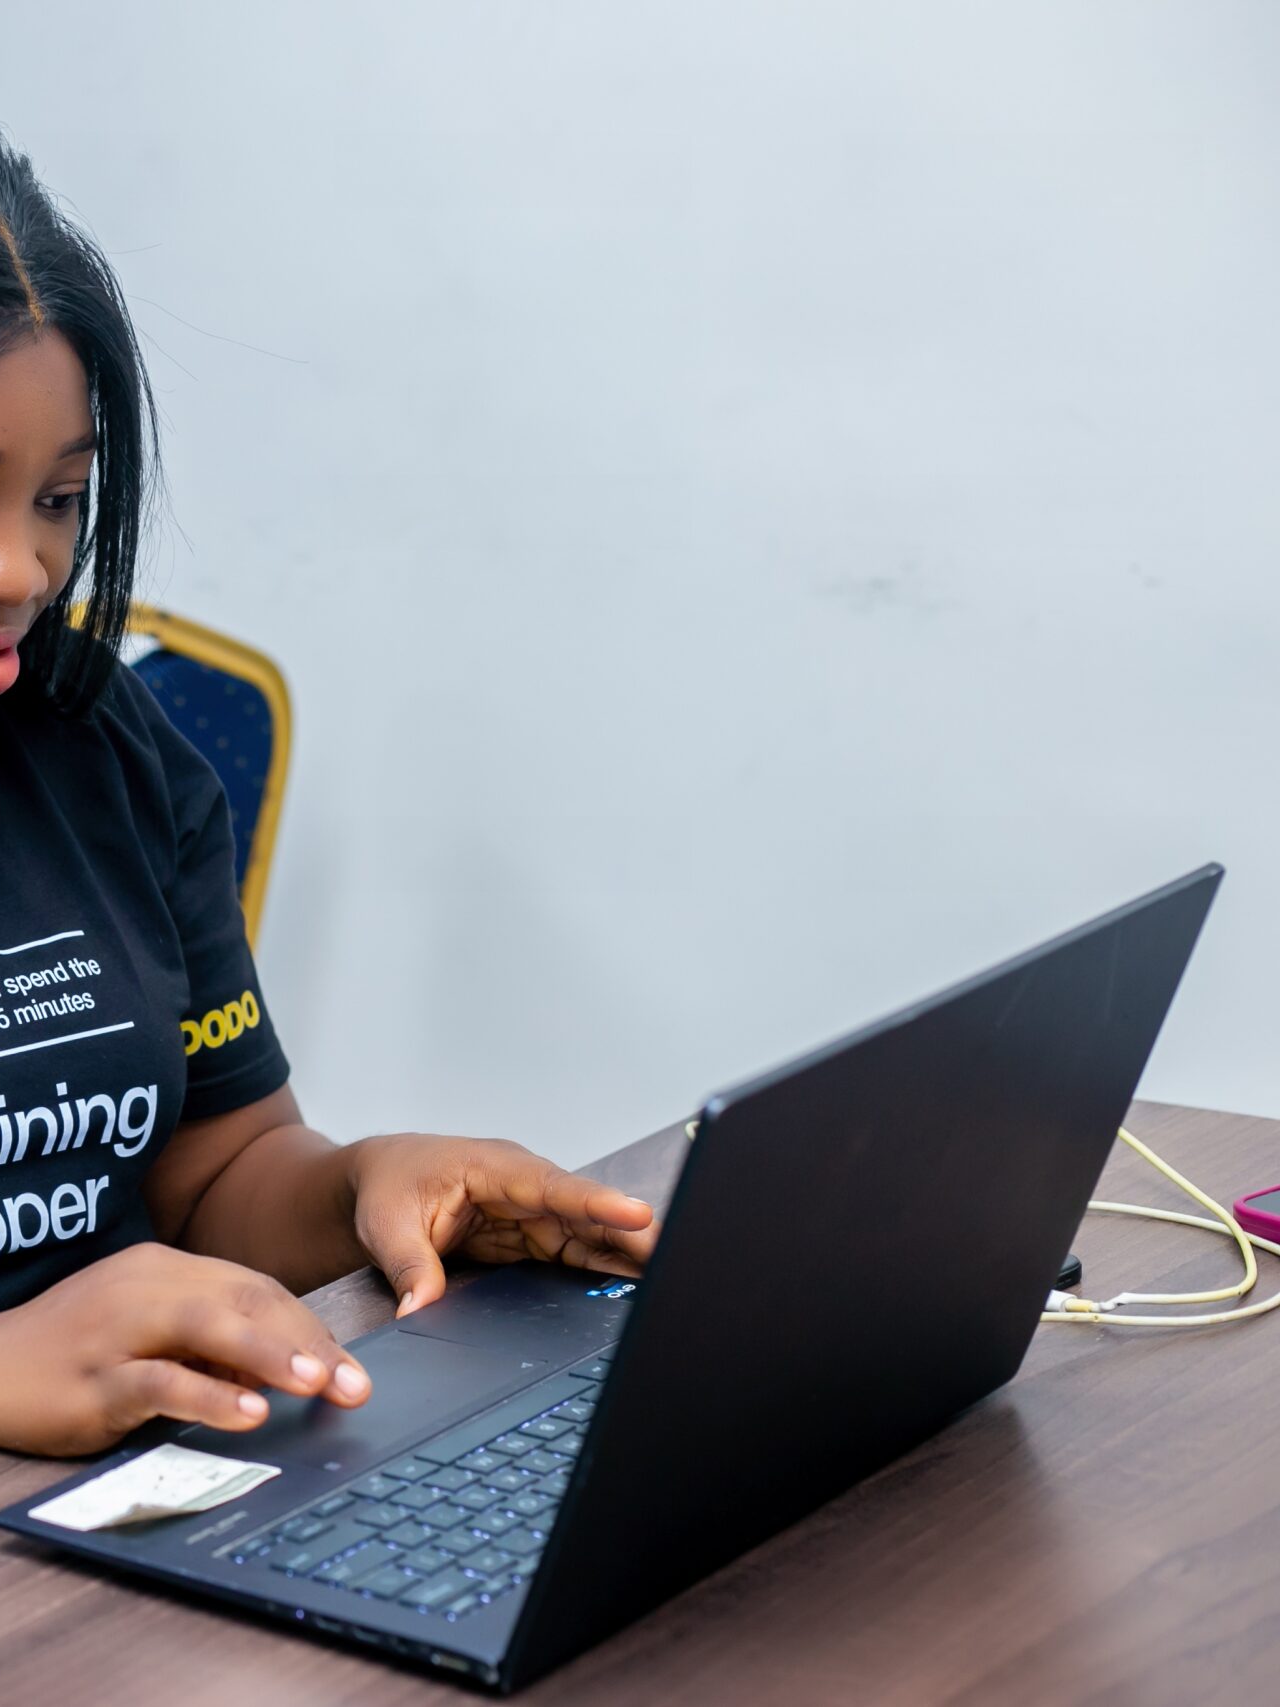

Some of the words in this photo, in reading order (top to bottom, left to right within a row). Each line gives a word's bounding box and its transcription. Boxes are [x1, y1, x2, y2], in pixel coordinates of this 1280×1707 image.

[3, 961, 70, 997] spend
[67, 957, 102, 978] the
[13, 992, 96, 1026] minutes
